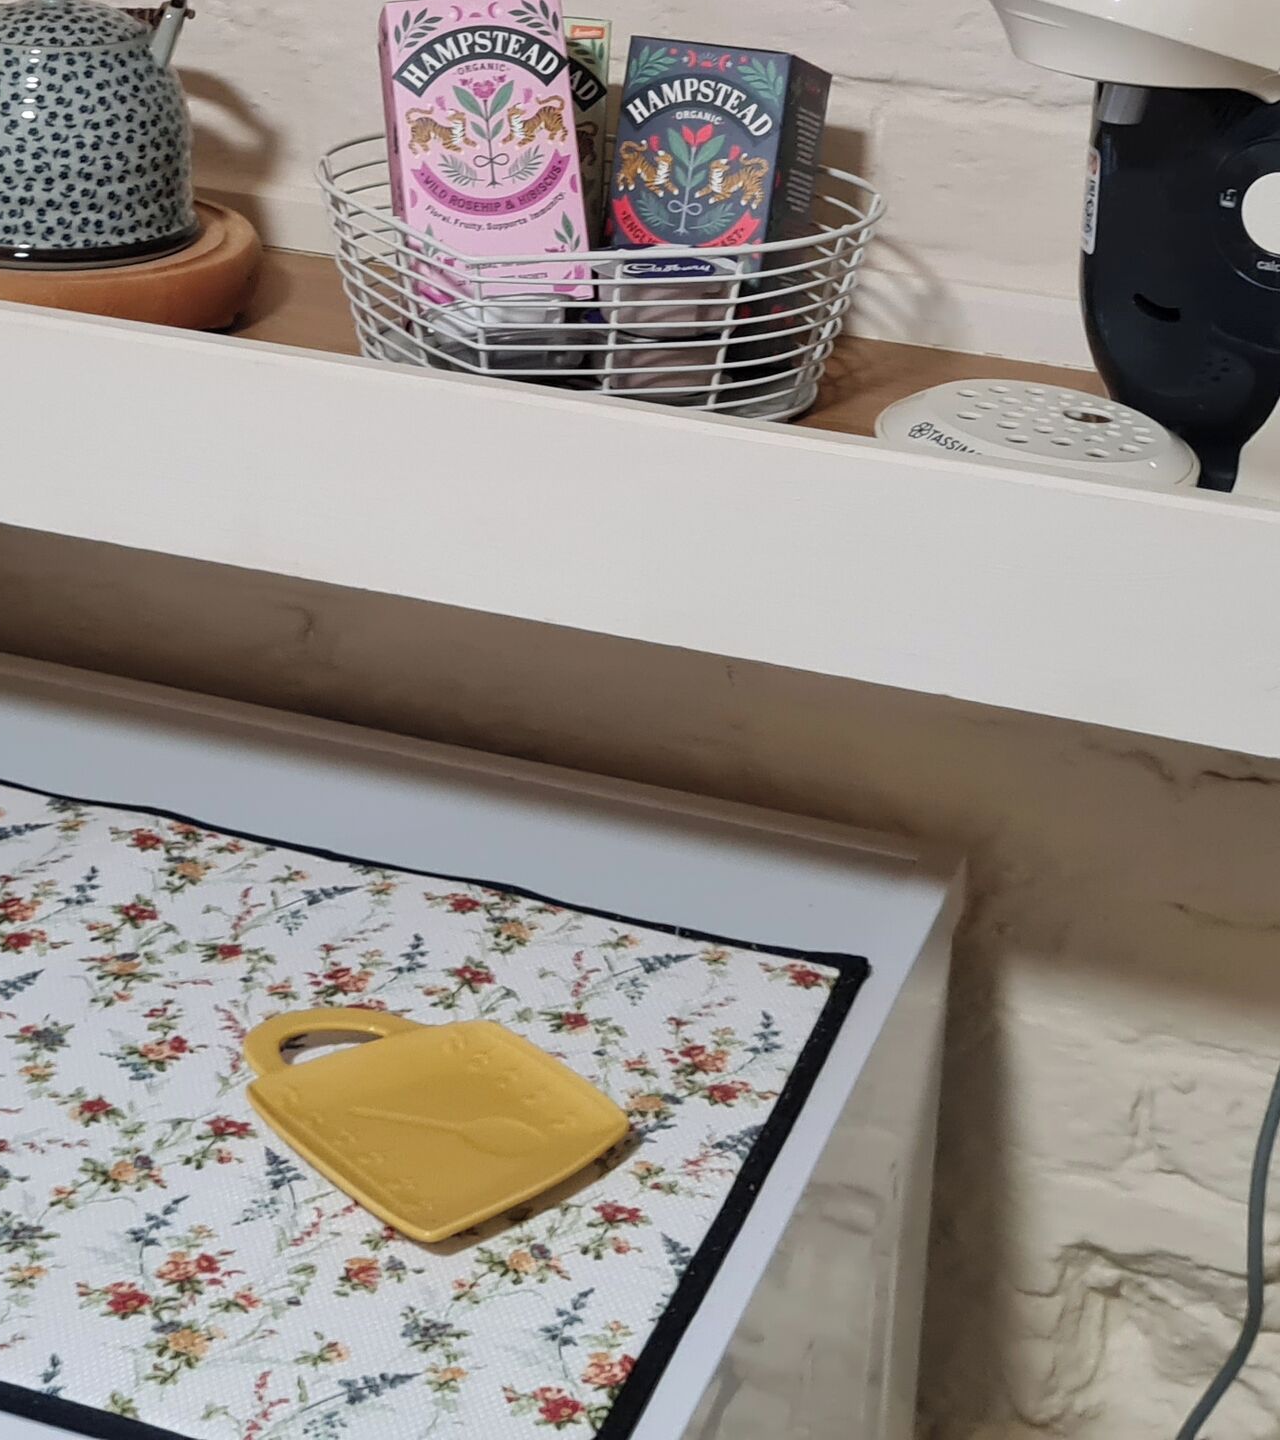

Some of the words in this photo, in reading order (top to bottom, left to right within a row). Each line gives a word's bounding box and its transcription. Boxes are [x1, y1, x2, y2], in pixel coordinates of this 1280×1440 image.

[401, 30, 559, 89] HAMPSTEAD
[457, 62, 506, 75] ORGANIC
[626, 78, 773, 137] HAMPSTEAD
[675, 110, 723, 125] ORGANIC
[424, 175, 447, 198] WILD
[449, 195, 501, 212] ROSEHIP
[505, 199, 516, 211] &
[518, 165, 562, 206] HIBISCUS
